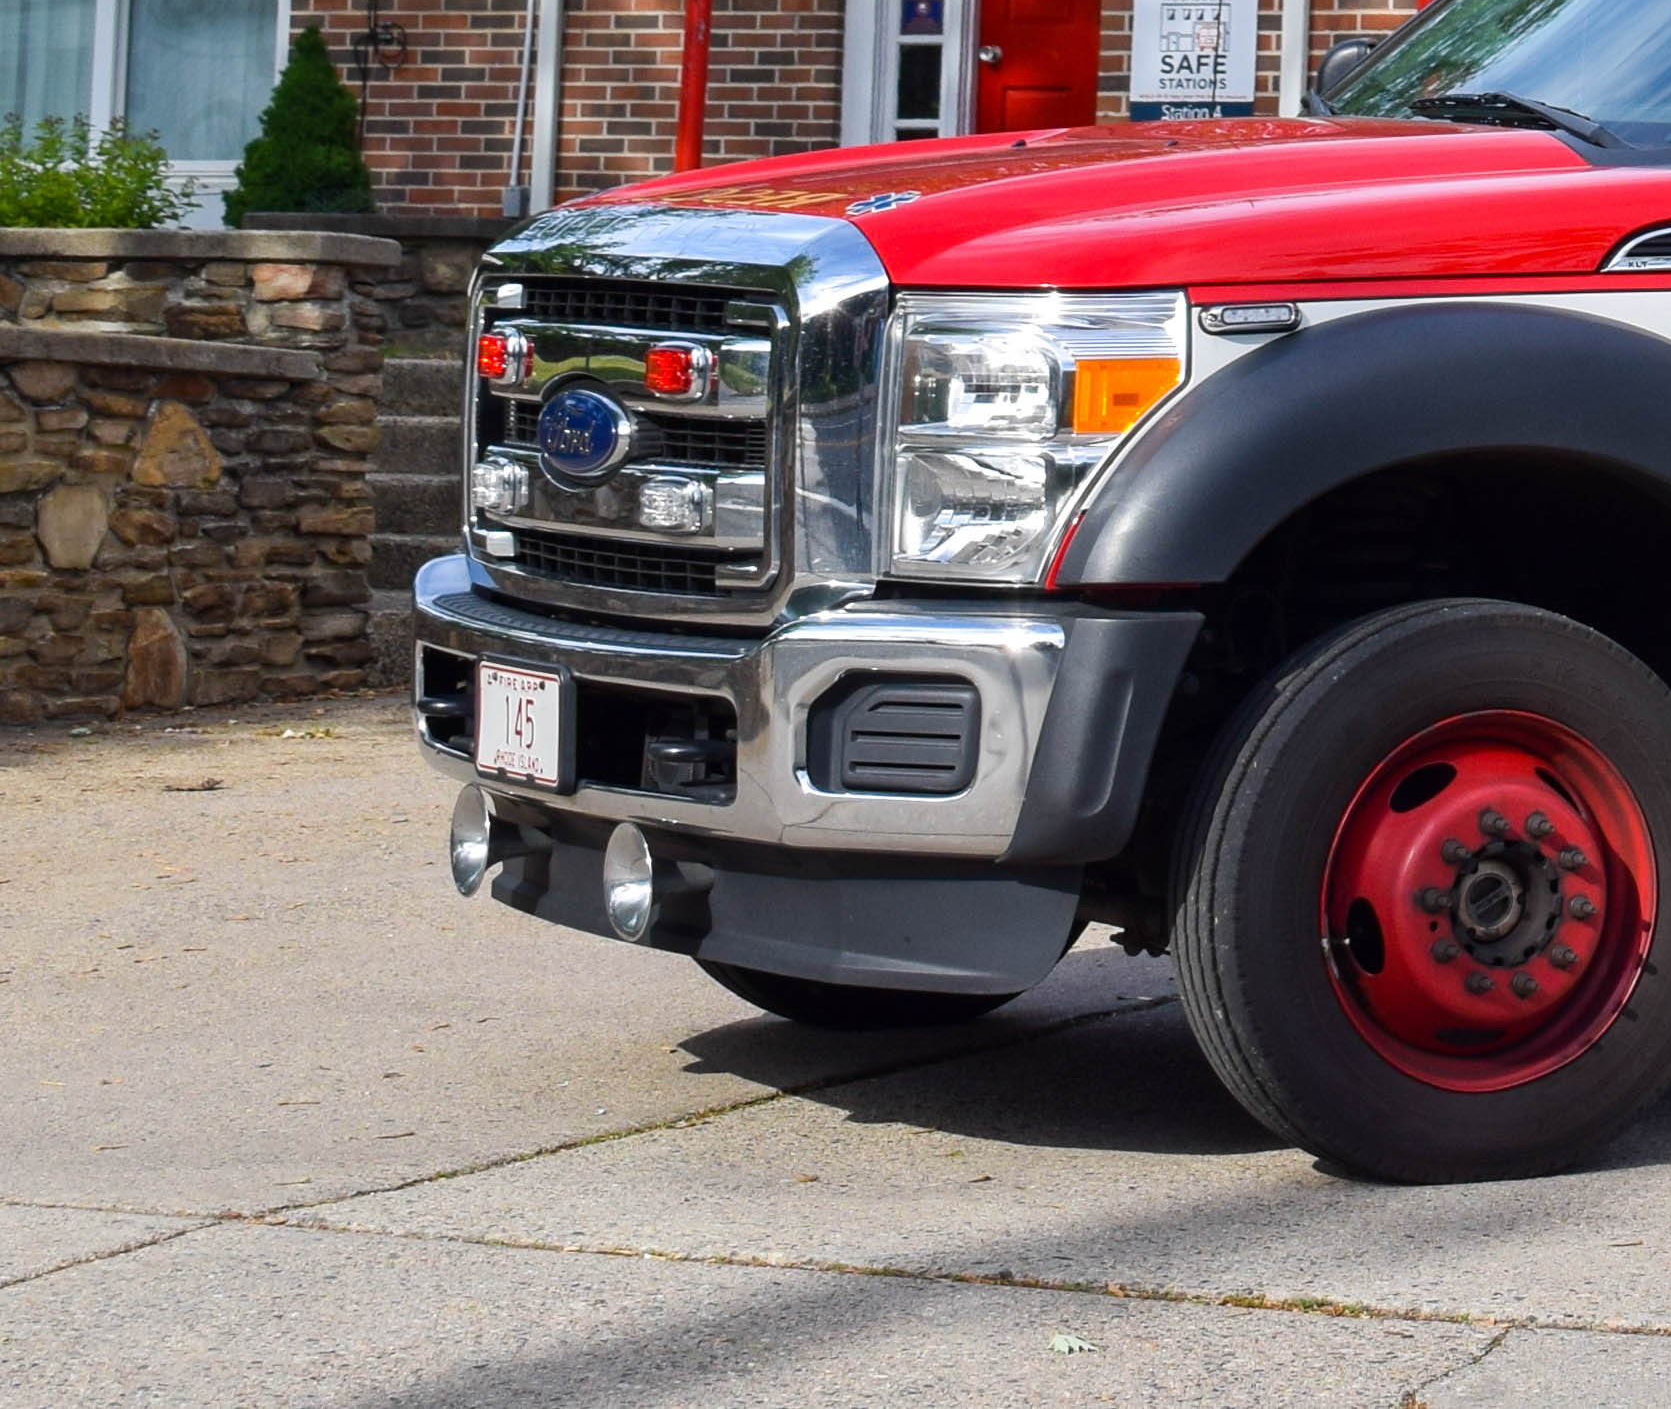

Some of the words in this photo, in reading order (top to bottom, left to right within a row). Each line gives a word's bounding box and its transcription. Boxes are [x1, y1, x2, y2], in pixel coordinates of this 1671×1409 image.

[1160, 54, 1228, 75] SAFE
[1159, 78, 1227, 90] STATIONS
[544, 412, 596, 454] Ford
[505, 694, 535, 749] 145
